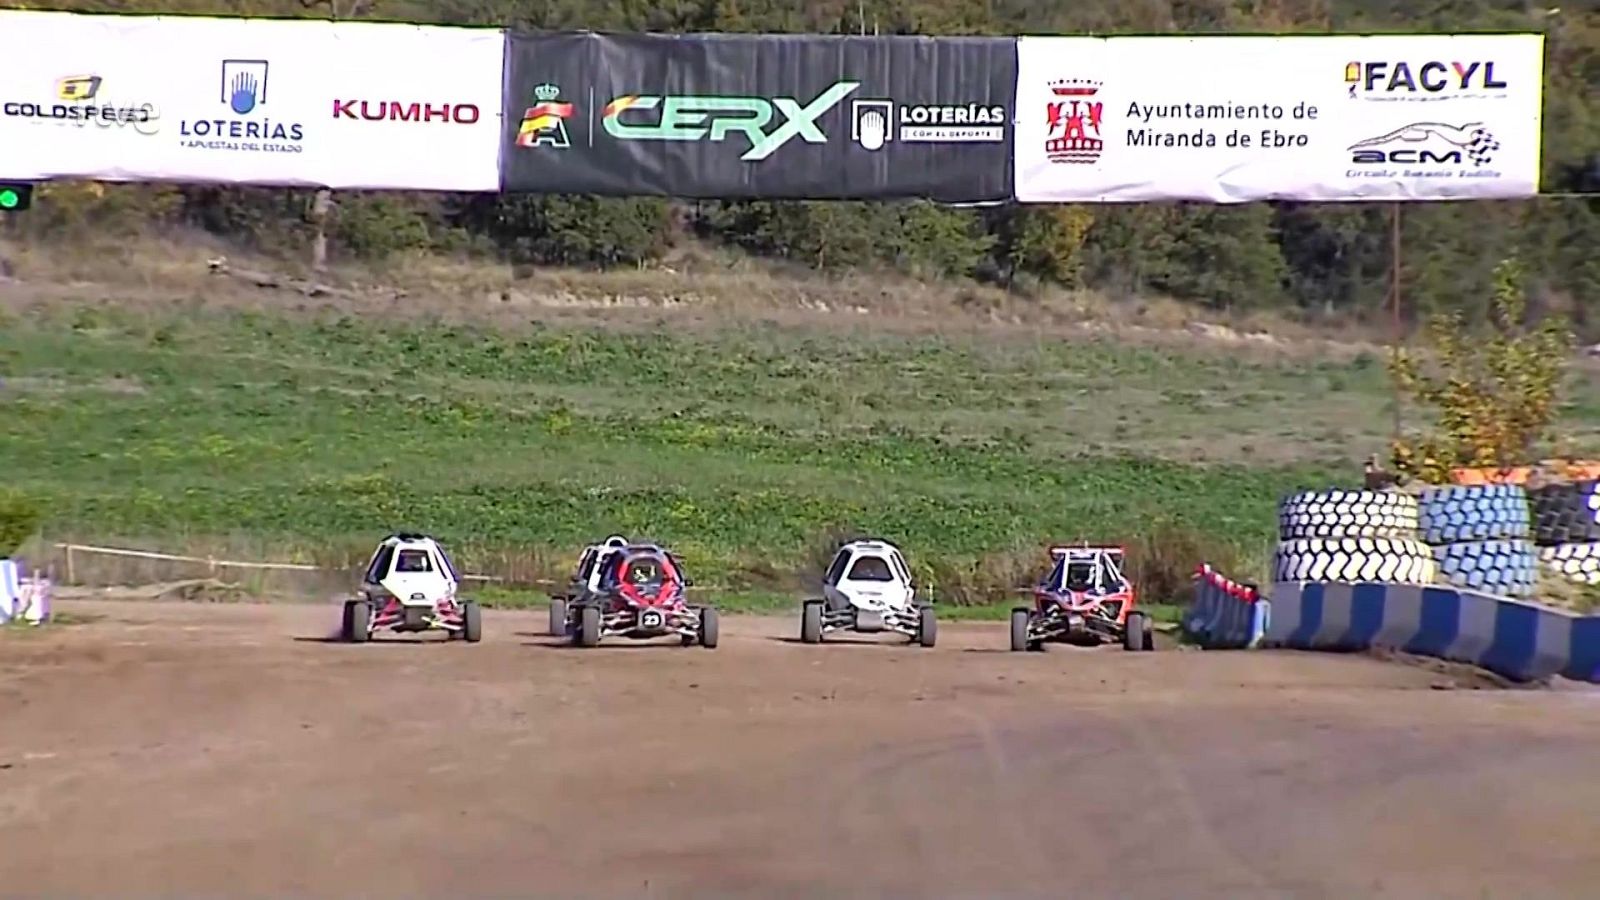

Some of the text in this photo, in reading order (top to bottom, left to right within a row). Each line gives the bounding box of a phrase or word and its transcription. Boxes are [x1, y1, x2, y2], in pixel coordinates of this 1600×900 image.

[1365, 61, 1507, 92] FACYL
[333, 99, 480, 124] KUMHO
[602, 82, 860, 161] CERX
[900, 103, 1004, 124] LOTERÍAS
[1127, 101, 1318, 122] Ayuntamiento de
[180, 117, 304, 140] LOTERÍAS
[1127, 129, 1309, 147] Miranda de Ebro
